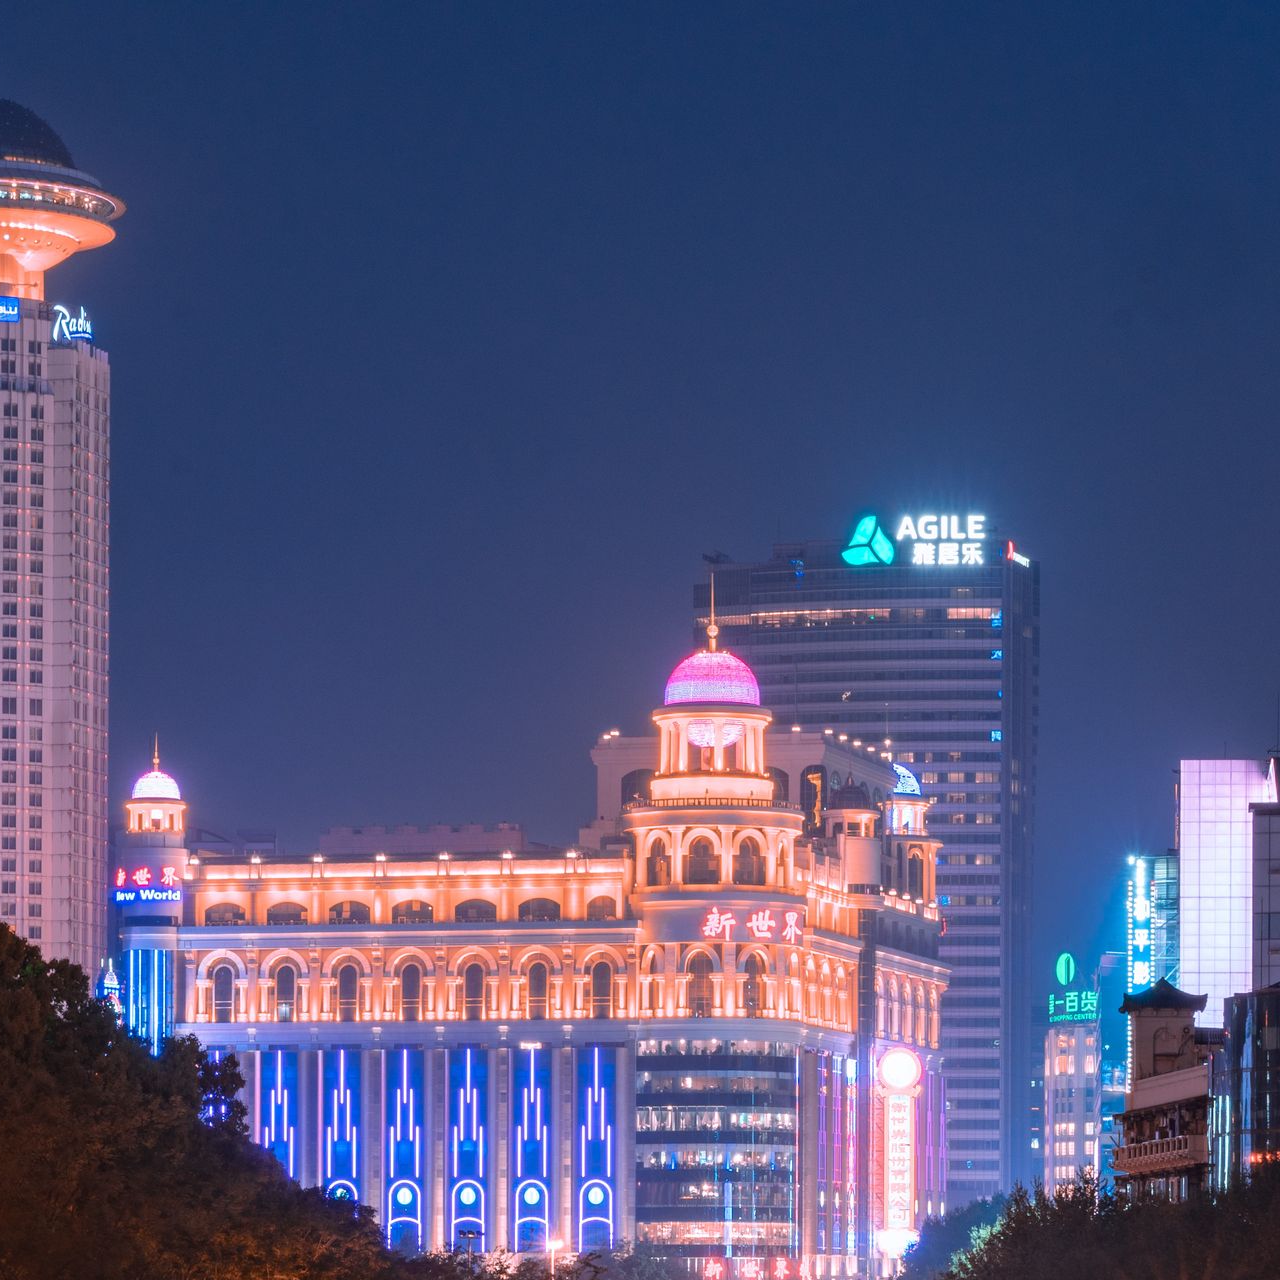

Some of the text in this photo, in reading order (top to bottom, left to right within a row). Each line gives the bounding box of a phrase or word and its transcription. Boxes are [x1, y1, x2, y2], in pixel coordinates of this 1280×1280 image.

[896, 515, 986, 541] AGILE
[912, 542, 984, 565] 雅居乐
[140, 889, 181, 901] World
[702, 906, 802, 944] 新世界
